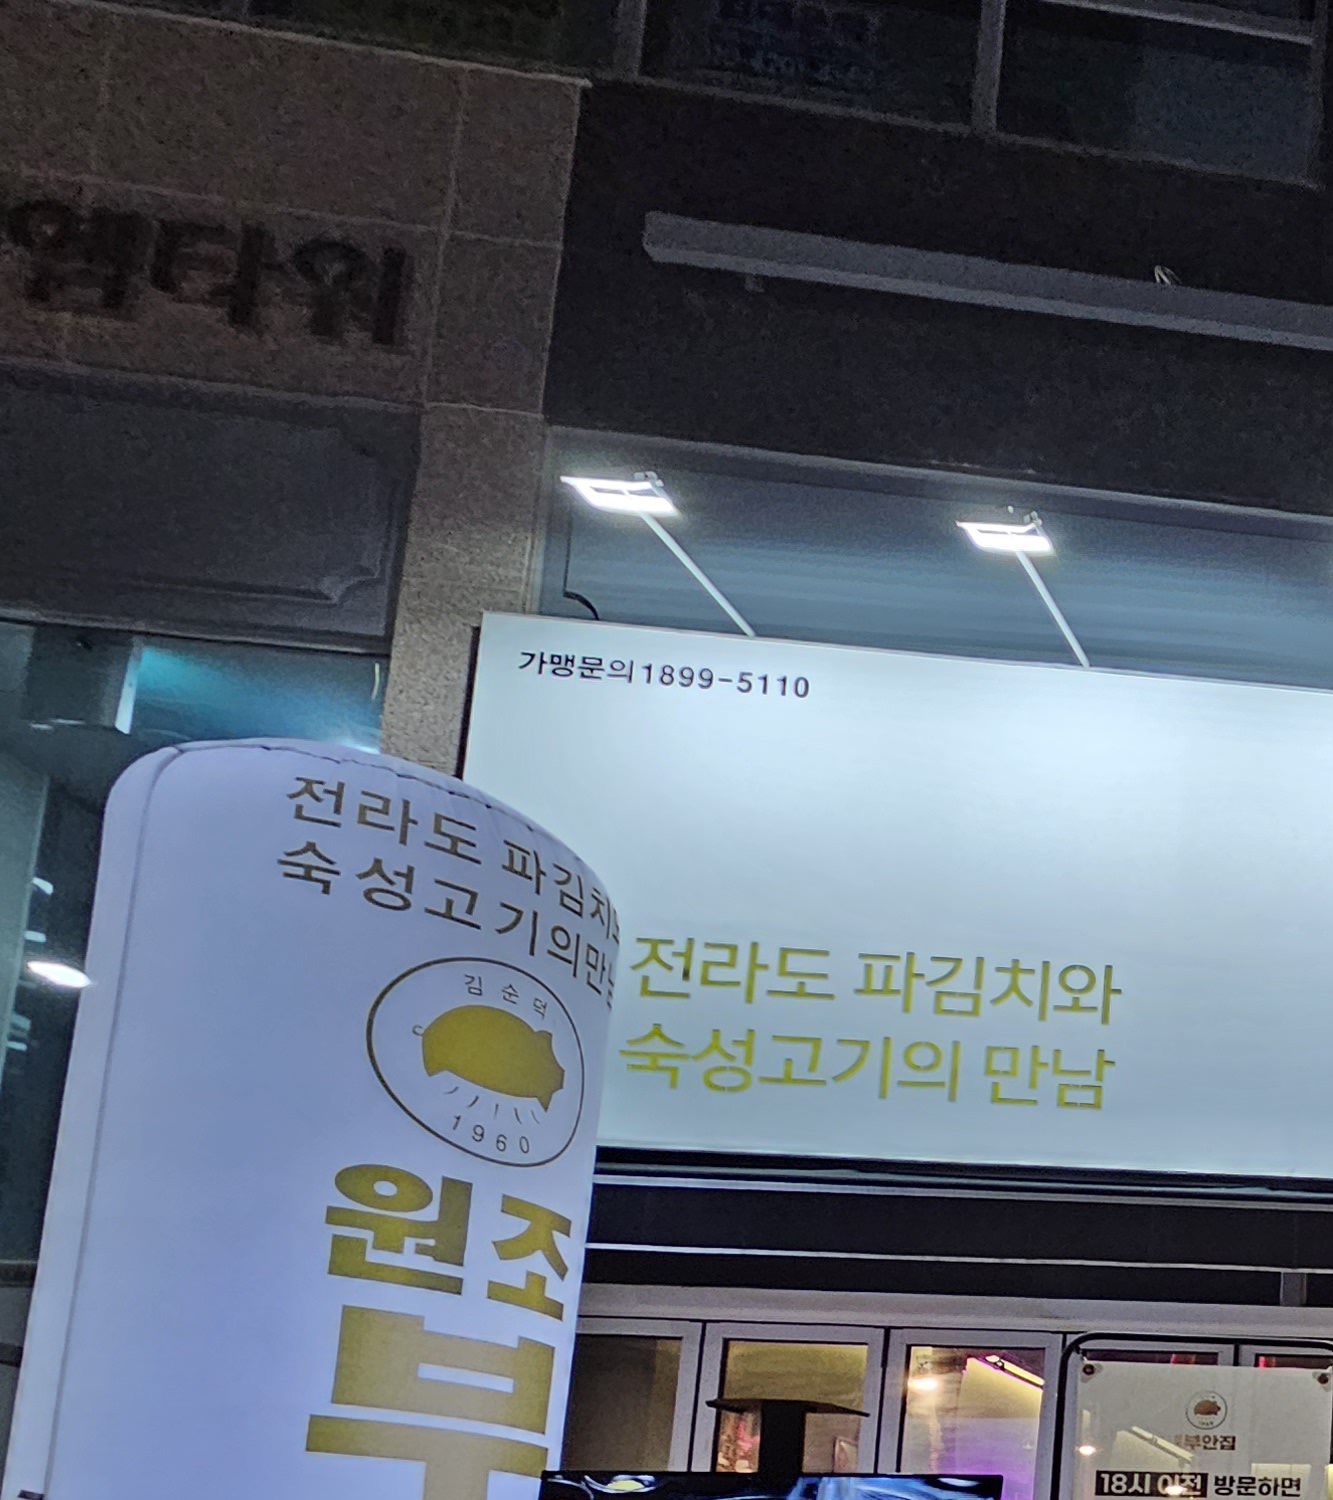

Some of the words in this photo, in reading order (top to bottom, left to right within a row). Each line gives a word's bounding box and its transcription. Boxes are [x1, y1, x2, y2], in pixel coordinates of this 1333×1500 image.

[286, 775, 483, 865] 전라도
[464, 973, 548, 1019] 김순덕
[630, 931, 837, 1007] 전라도
[853, 948, 1122, 1029] 파김치와
[618, 1021, 963, 1104] 숙성고기의
[981, 1038, 1117, 1111] 만남
[451, 1114, 530, 1155] 1960
[325, 1163, 572, 1322] 원조
[1184, 1434, 1236, 1451] 부안집
[1099, 1473, 1151, 1495] 18시
[1214, 1474, 1301, 1498] 방문하면
